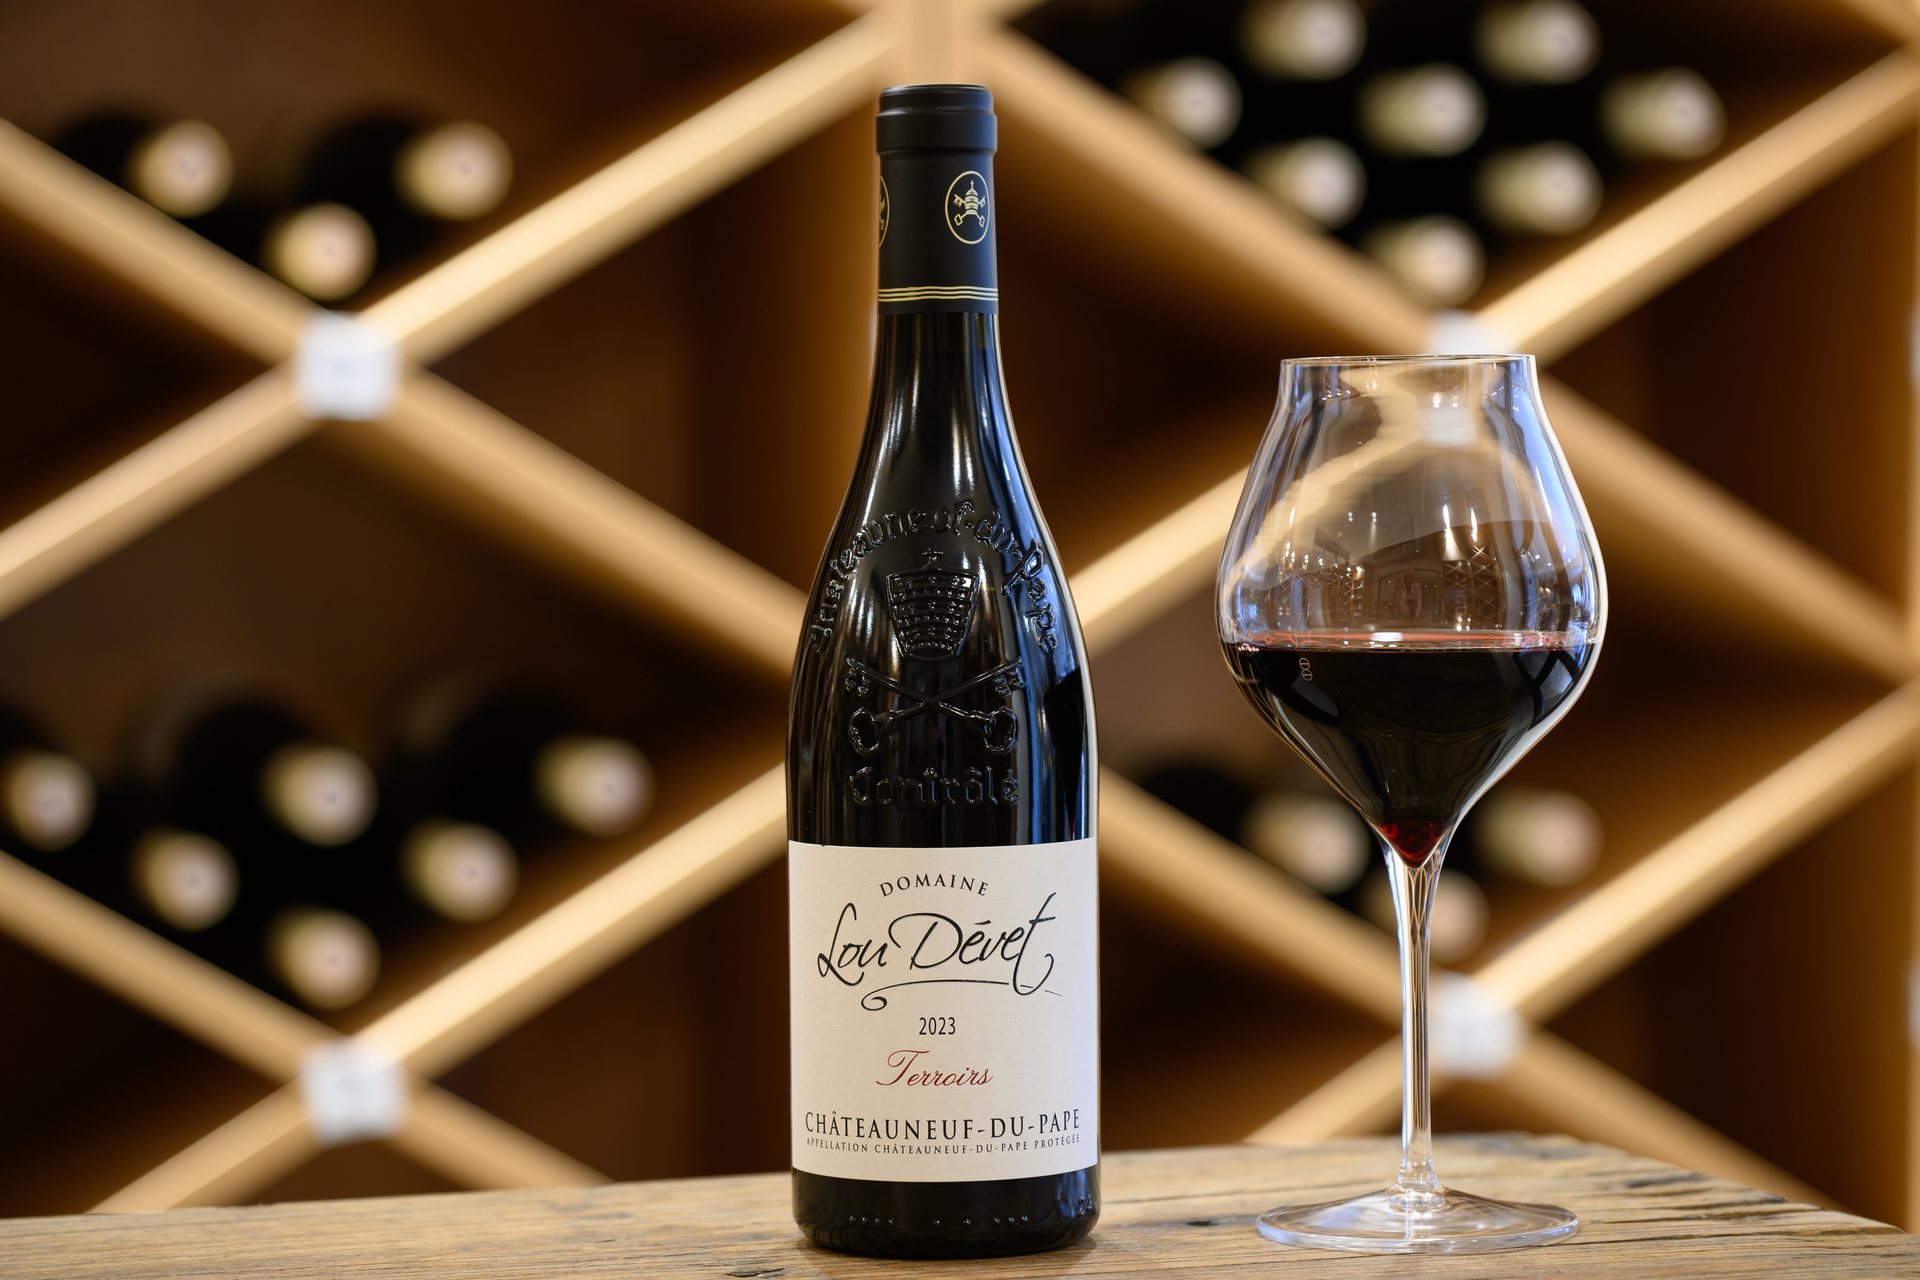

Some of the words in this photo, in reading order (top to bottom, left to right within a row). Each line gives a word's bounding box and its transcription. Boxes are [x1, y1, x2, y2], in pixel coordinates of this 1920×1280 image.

[879, 873, 989, 897] DOMAINE
[817, 902, 889, 987] Lou
[887, 892, 1057, 996] Dévet
[918, 1016, 957, 1036] 2023
[875, 1049, 994, 1087] Terroirs
[805, 1108, 1080, 1140] CHÂTEAUNEUF-DU-PAPE
[806, 1137, 868, 1153] APPELLATION
[874, 1141, 1028, 1155] CHÂTEAUNEUF-DU-PAPE
[1034, 1132, 1080, 1150] PROTÉGÉE
